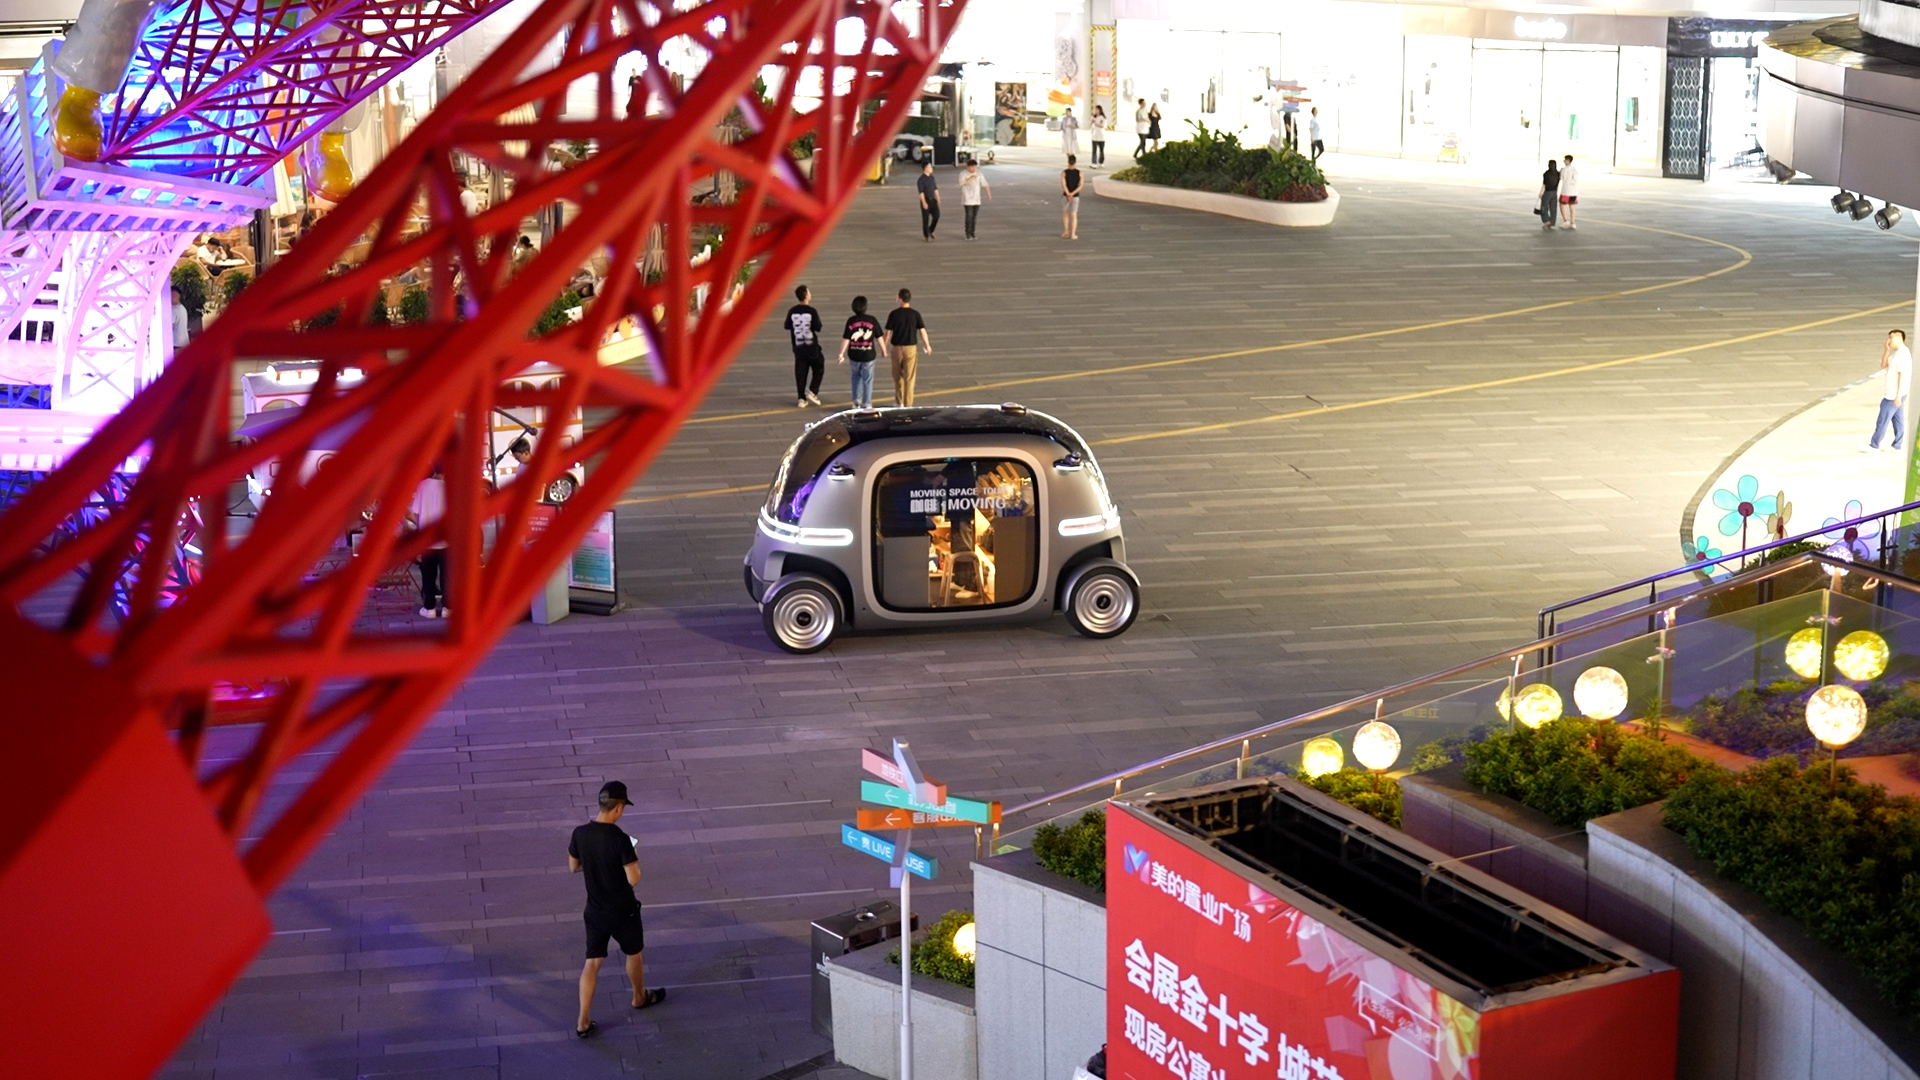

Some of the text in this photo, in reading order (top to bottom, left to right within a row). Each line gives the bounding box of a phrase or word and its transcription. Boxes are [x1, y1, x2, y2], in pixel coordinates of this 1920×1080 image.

[910, 489, 946, 498] MOVING
[949, 487, 977, 496] SPACE
[948, 498, 1006, 511] MOVING
[872, 841, 892, 859] LIVE
[905, 857, 925, 874] USE
[1151, 861, 1252, 943] 美的置业广场
[1124, 938, 1269, 1066] 会展金十字
[1124, 1004, 1226, 1080] 现房公寓
